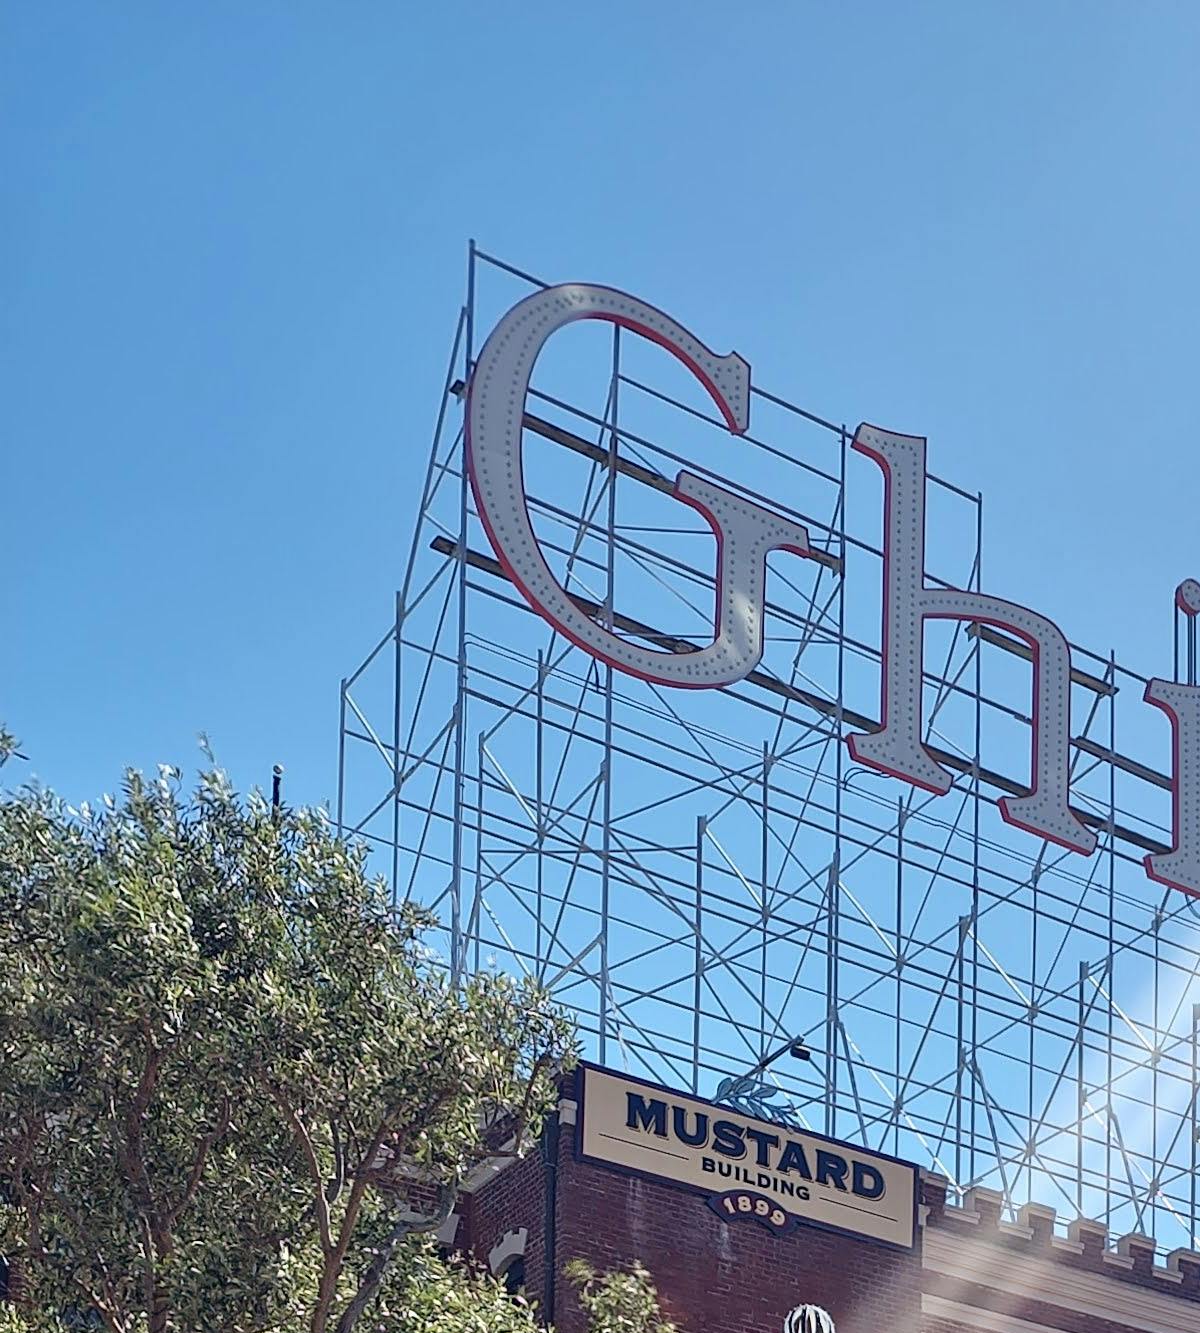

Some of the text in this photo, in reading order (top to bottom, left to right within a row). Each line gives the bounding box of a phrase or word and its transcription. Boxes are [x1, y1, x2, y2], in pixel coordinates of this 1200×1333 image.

[625, 1091, 887, 1201] MUSTARD
[702, 1156, 810, 1201] BUILDING
[723, 1195, 786, 1227] 1899
